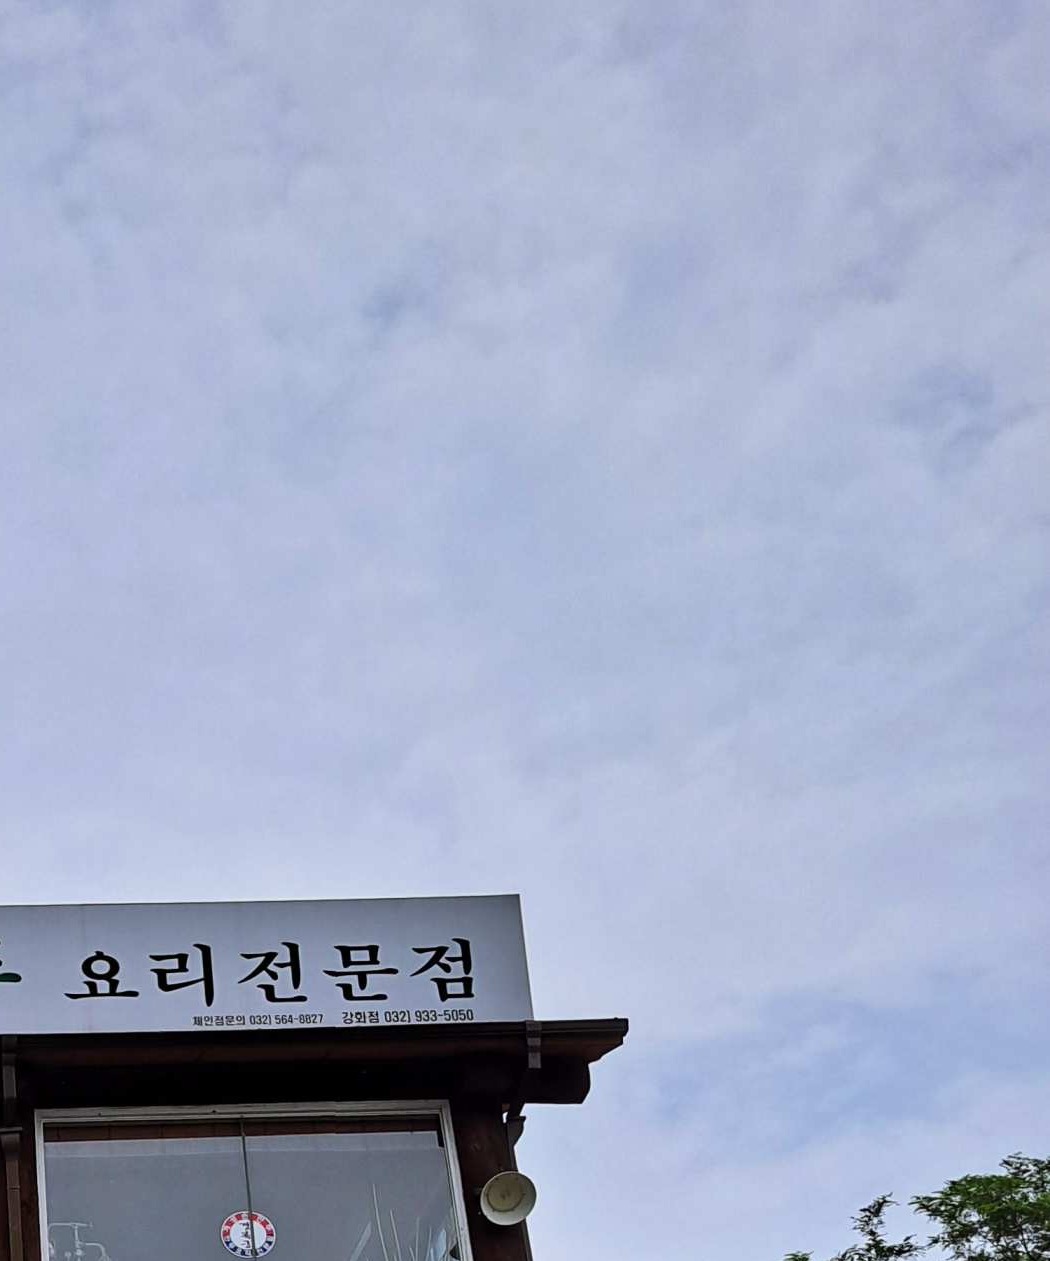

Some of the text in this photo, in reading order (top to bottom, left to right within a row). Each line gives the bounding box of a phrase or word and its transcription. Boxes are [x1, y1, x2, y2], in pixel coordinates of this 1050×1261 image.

[64, 937, 476, 1007] 요리전문점
[193, 1015, 246, 1026] 체인점문의
[342, 1010, 380, 1024] 강화점
[415, 1009, 475, 1022] 933-5050
